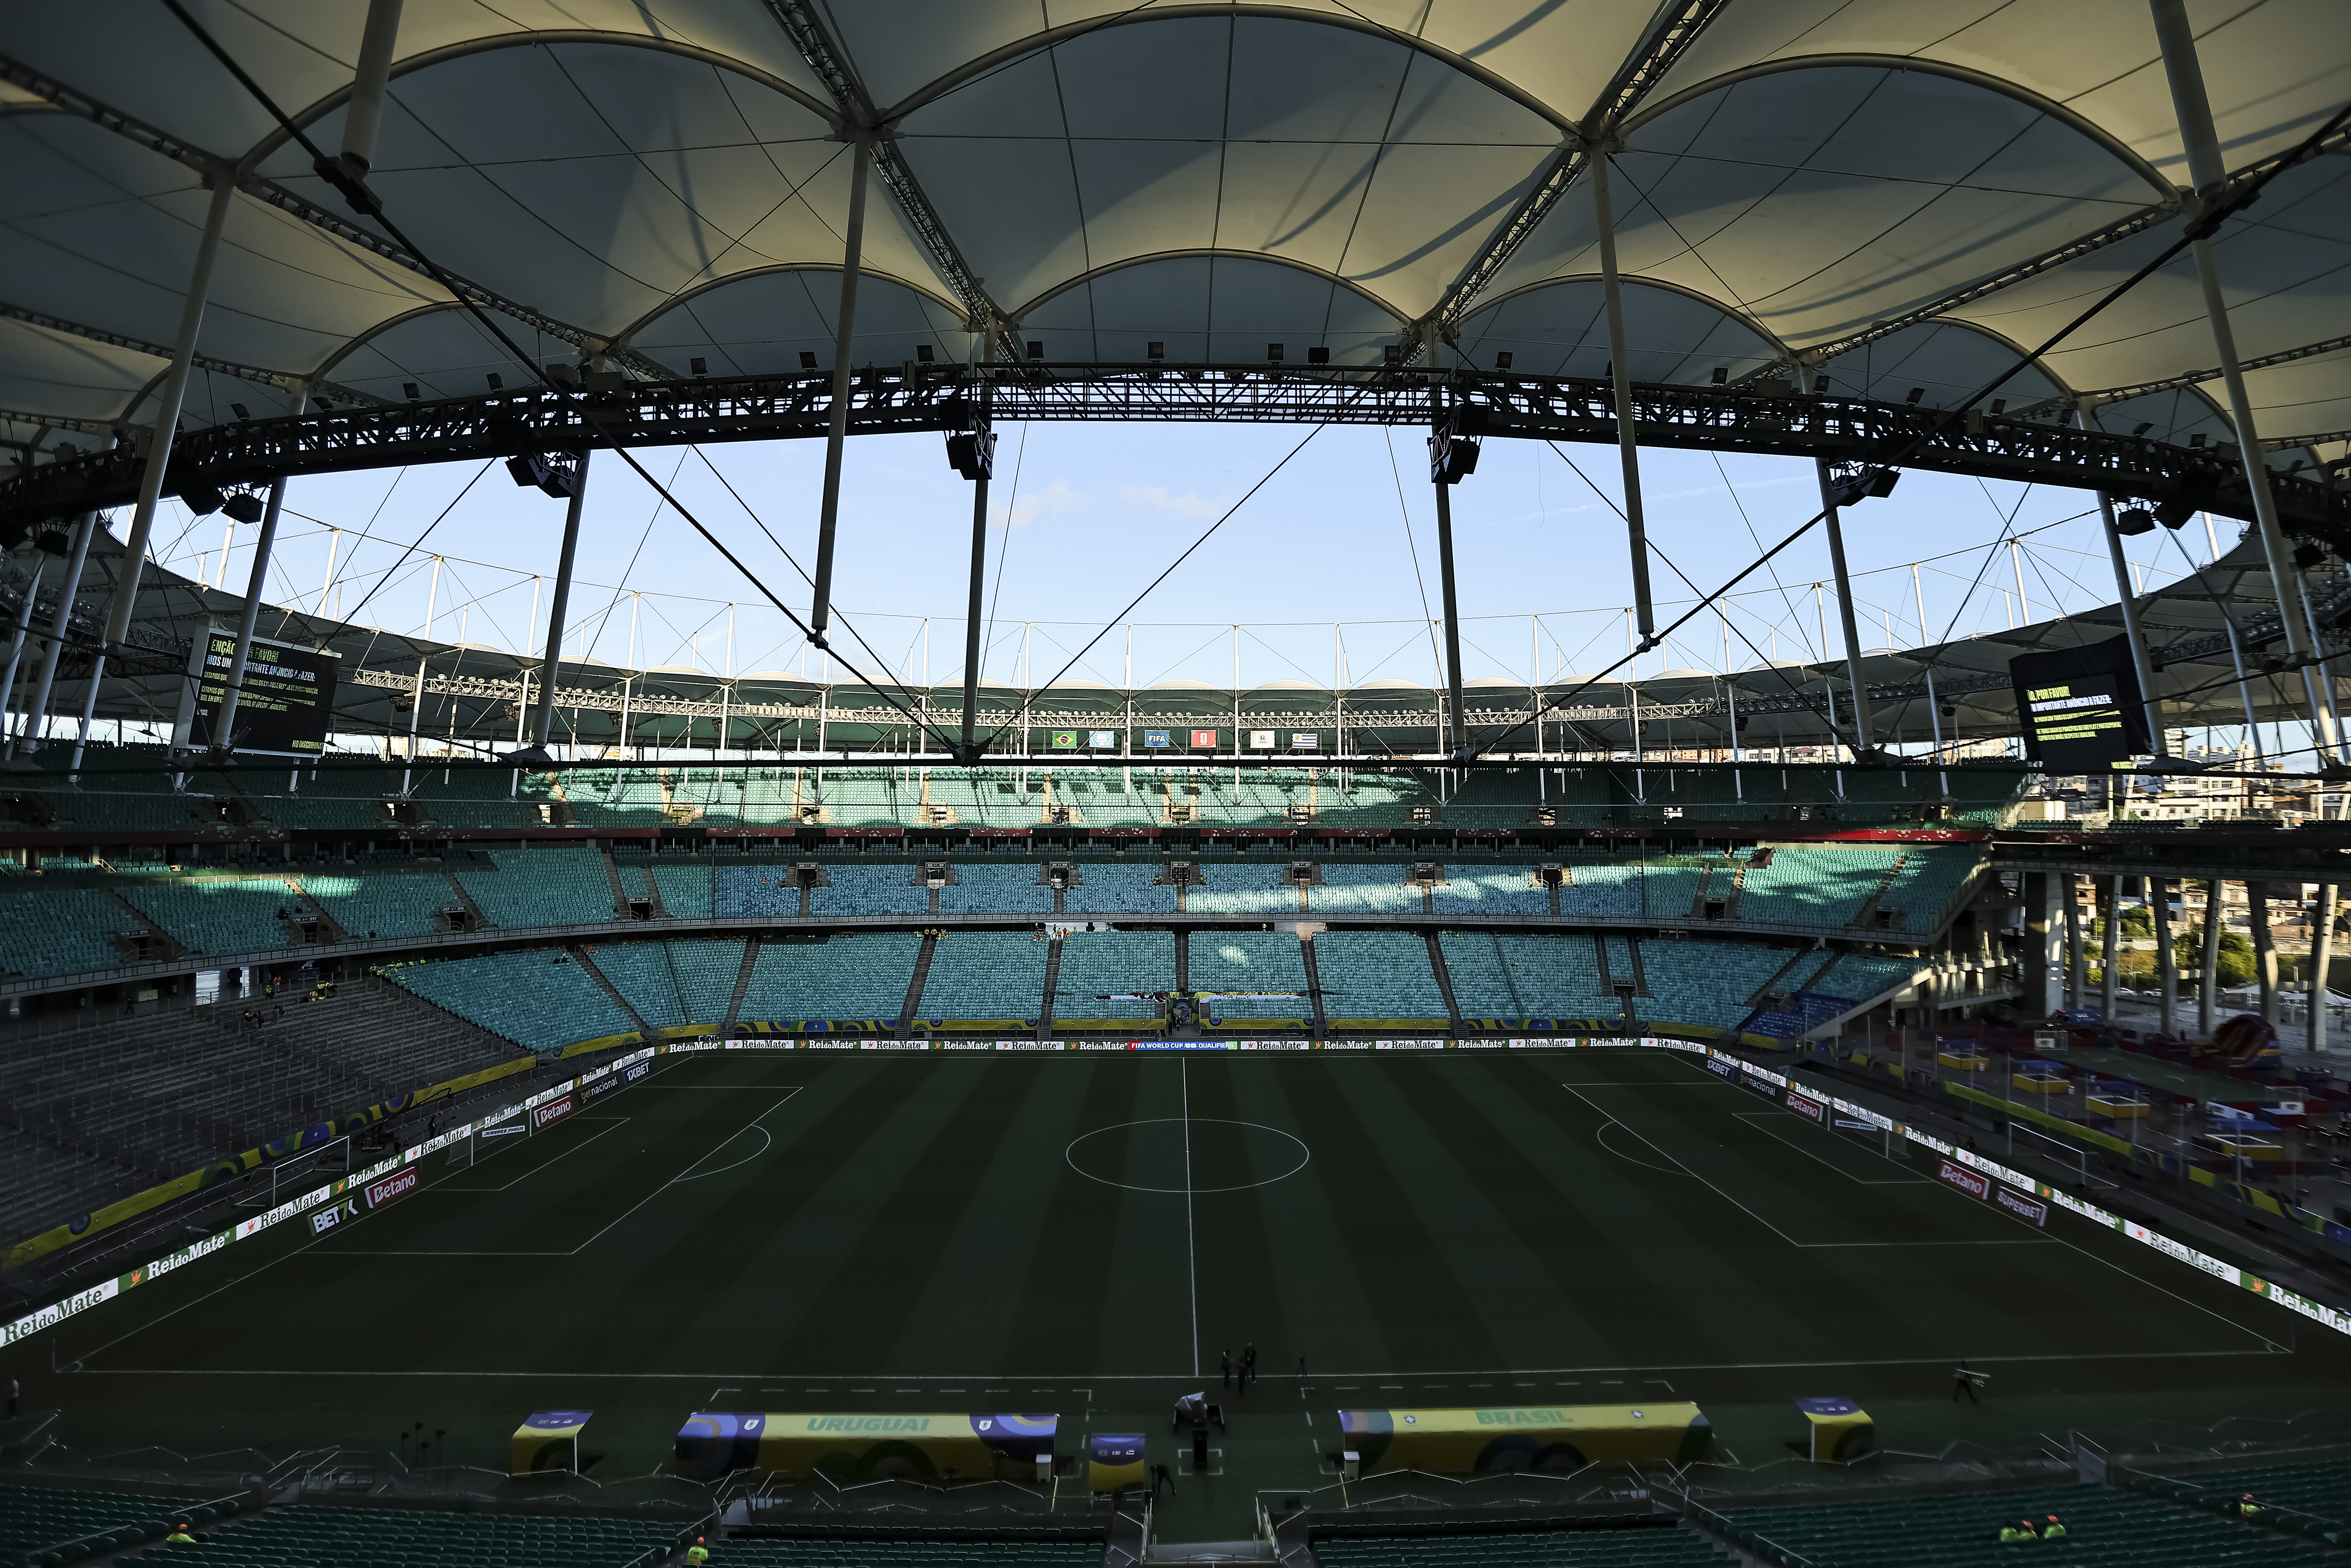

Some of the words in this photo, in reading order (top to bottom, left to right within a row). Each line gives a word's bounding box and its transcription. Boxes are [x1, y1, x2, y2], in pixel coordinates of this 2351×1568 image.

[221, 657, 232, 669] UM
[204, 671, 220, 680] CITAMOS
[2035, 689, 2049, 700] POR
[2047, 686, 2070, 699] FAVOR!
[2036, 700, 2067, 711] IMPORTANTE
[2065, 697, 2090, 709] ANÚNCIO
[2088, 696, 2094, 706] A
[2091, 694, 2112, 705] FAZER:
[627, 1062, 649, 1081] 1XBET
[1708, 1060, 1731, 1076] 1XBET
[581, 1077, 618, 1101] betnacional
[1740, 1073, 1775, 1096] betnacional
[540, 1101, 571, 1124] Betano
[1787, 1095, 1818, 1117] Betano
[373, 1174, 416, 1203] Betano
[1941, 1164, 1982, 1194] Betano
[1997, 1191, 2041, 1220] SUPERBET
[807, 1418, 930, 1431] URUGUAI
[1475, 1410, 1574, 1425] BRASIL
